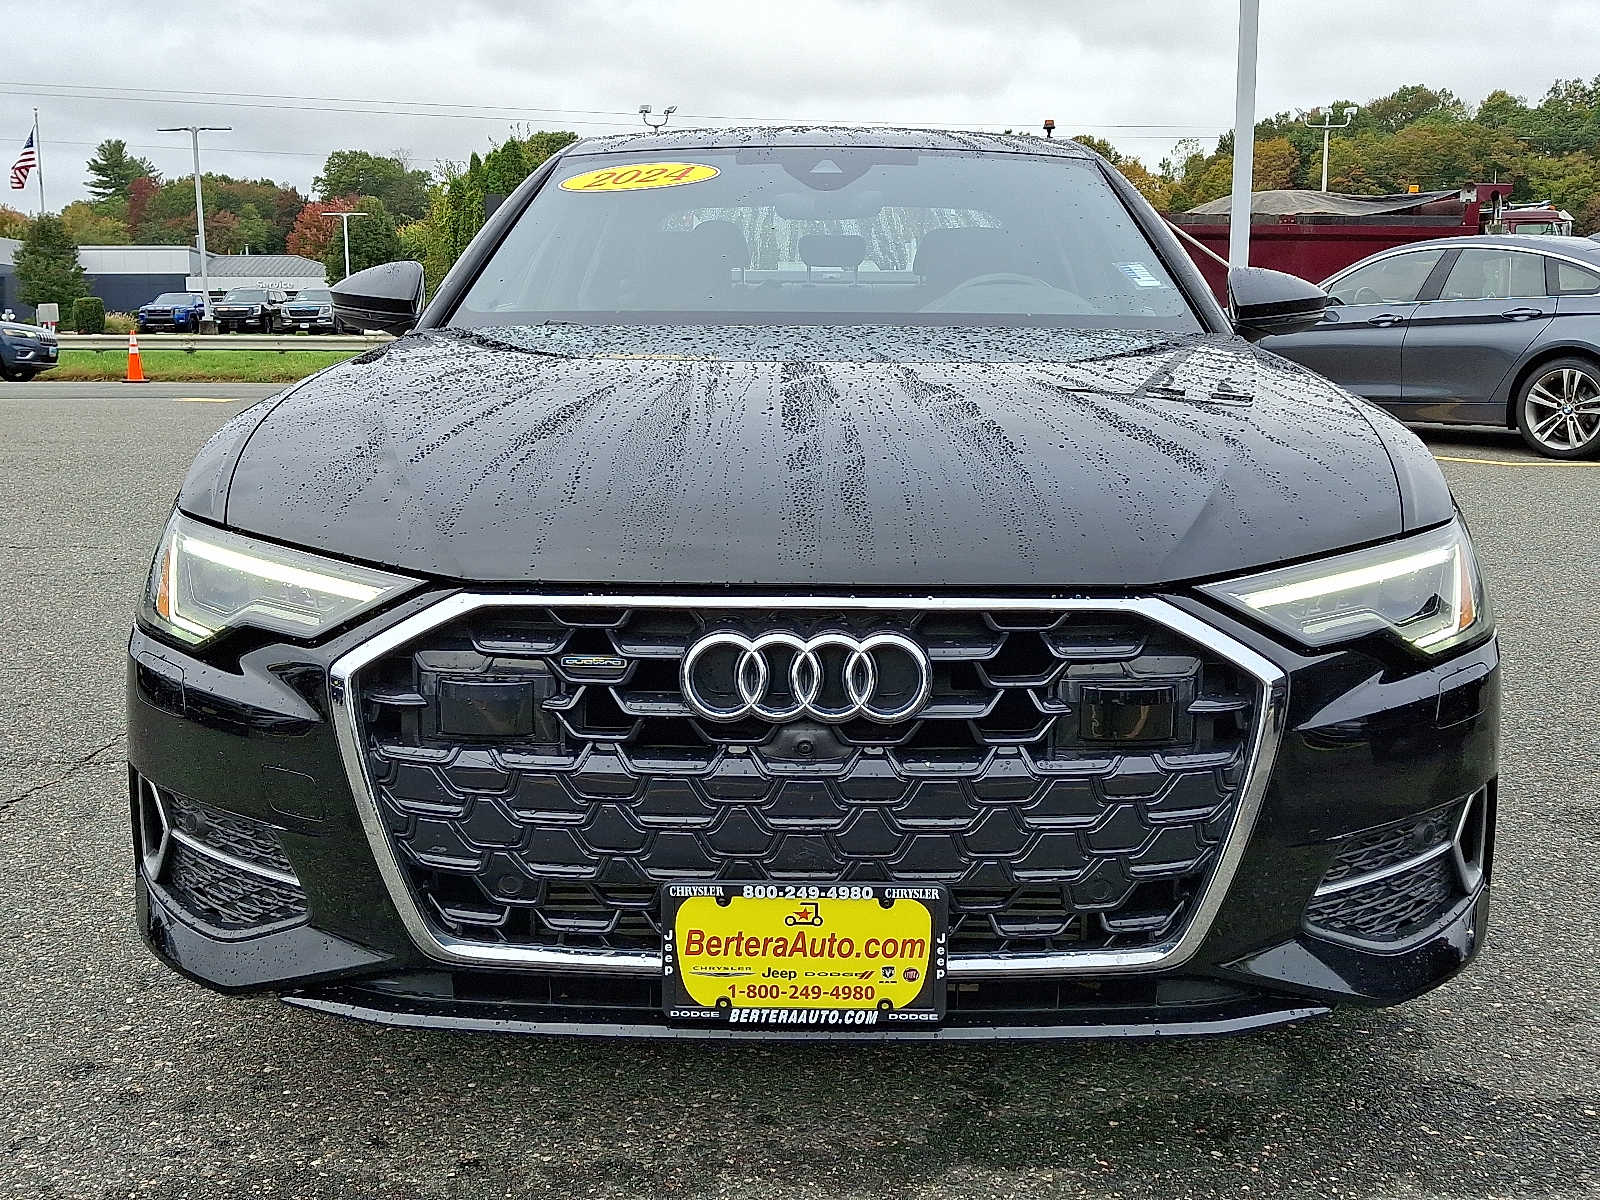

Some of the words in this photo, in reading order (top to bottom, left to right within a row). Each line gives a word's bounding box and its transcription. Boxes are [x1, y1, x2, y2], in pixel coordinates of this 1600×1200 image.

[583, 166, 695, 188] 2024
[256, 280, 294, 289] Service
[669, 886, 725, 897] CHRYSLER
[884, 888, 940, 899] CHRYSLER
[685, 929, 925, 958] BerteraAuto.com
[663, 929, 673, 975] Jeep
[936, 933, 946, 979] Jeep
[761, 967, 798, 980] Jeep
[728, 984, 875, 1000] 1-800-249-4980
[730, 1009, 878, 1024] BERTERAAUTO.COM
